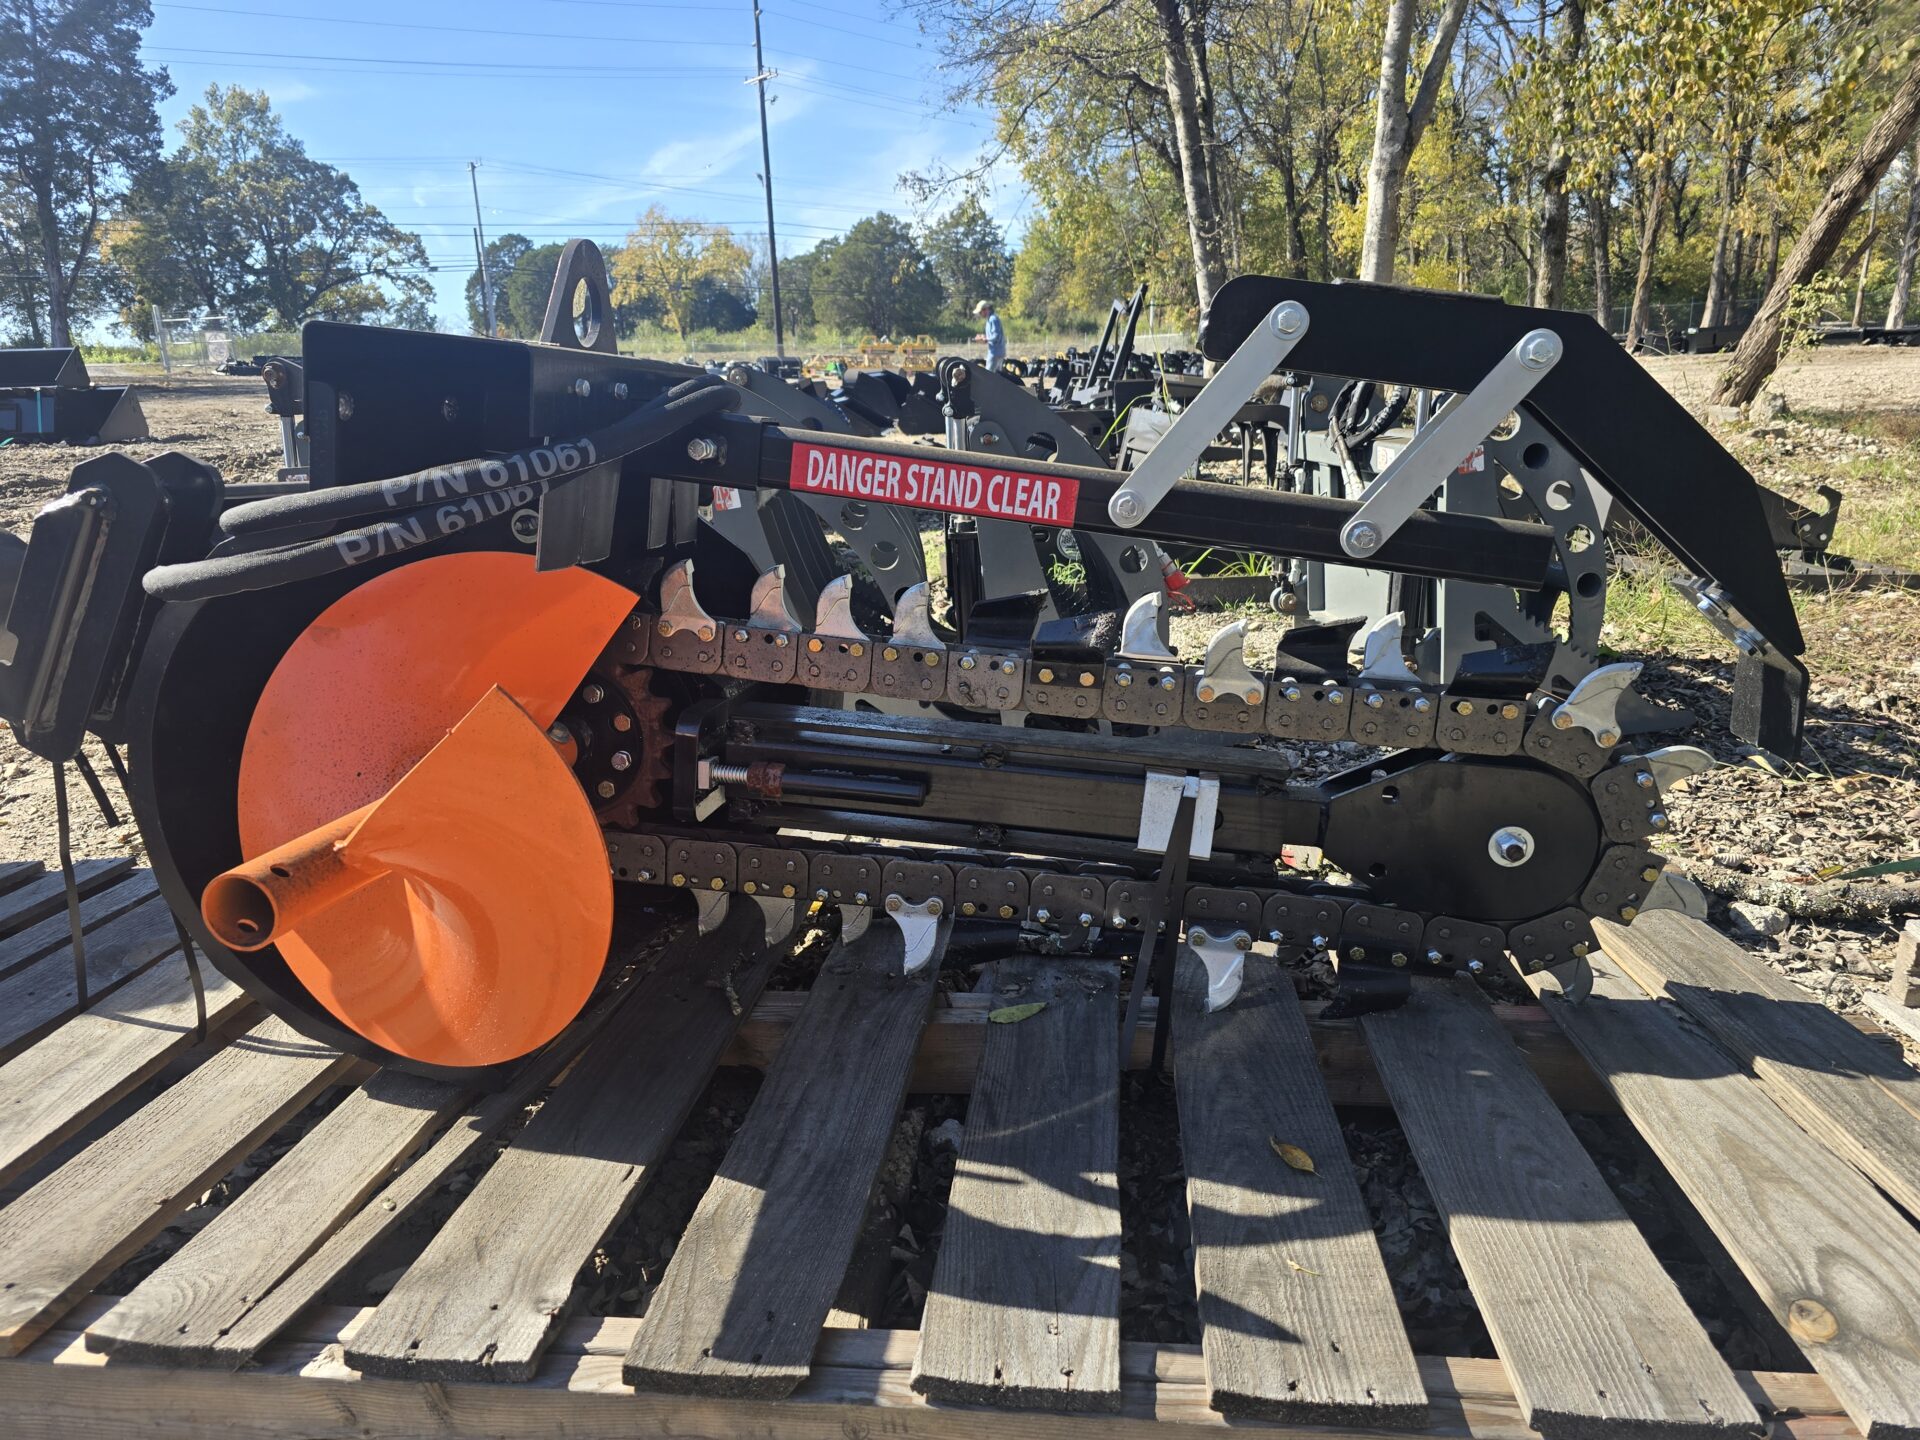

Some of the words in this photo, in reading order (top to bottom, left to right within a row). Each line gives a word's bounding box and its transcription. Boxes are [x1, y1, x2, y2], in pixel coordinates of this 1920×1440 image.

[381, 464, 469, 507] P/N
[480, 438, 597, 489] 61061
[806, 450, 901, 498] DANGER
[905, 464, 982, 509] STAND
[987, 475, 1061, 520] CLEAR
[335, 516, 427, 566] P/N
